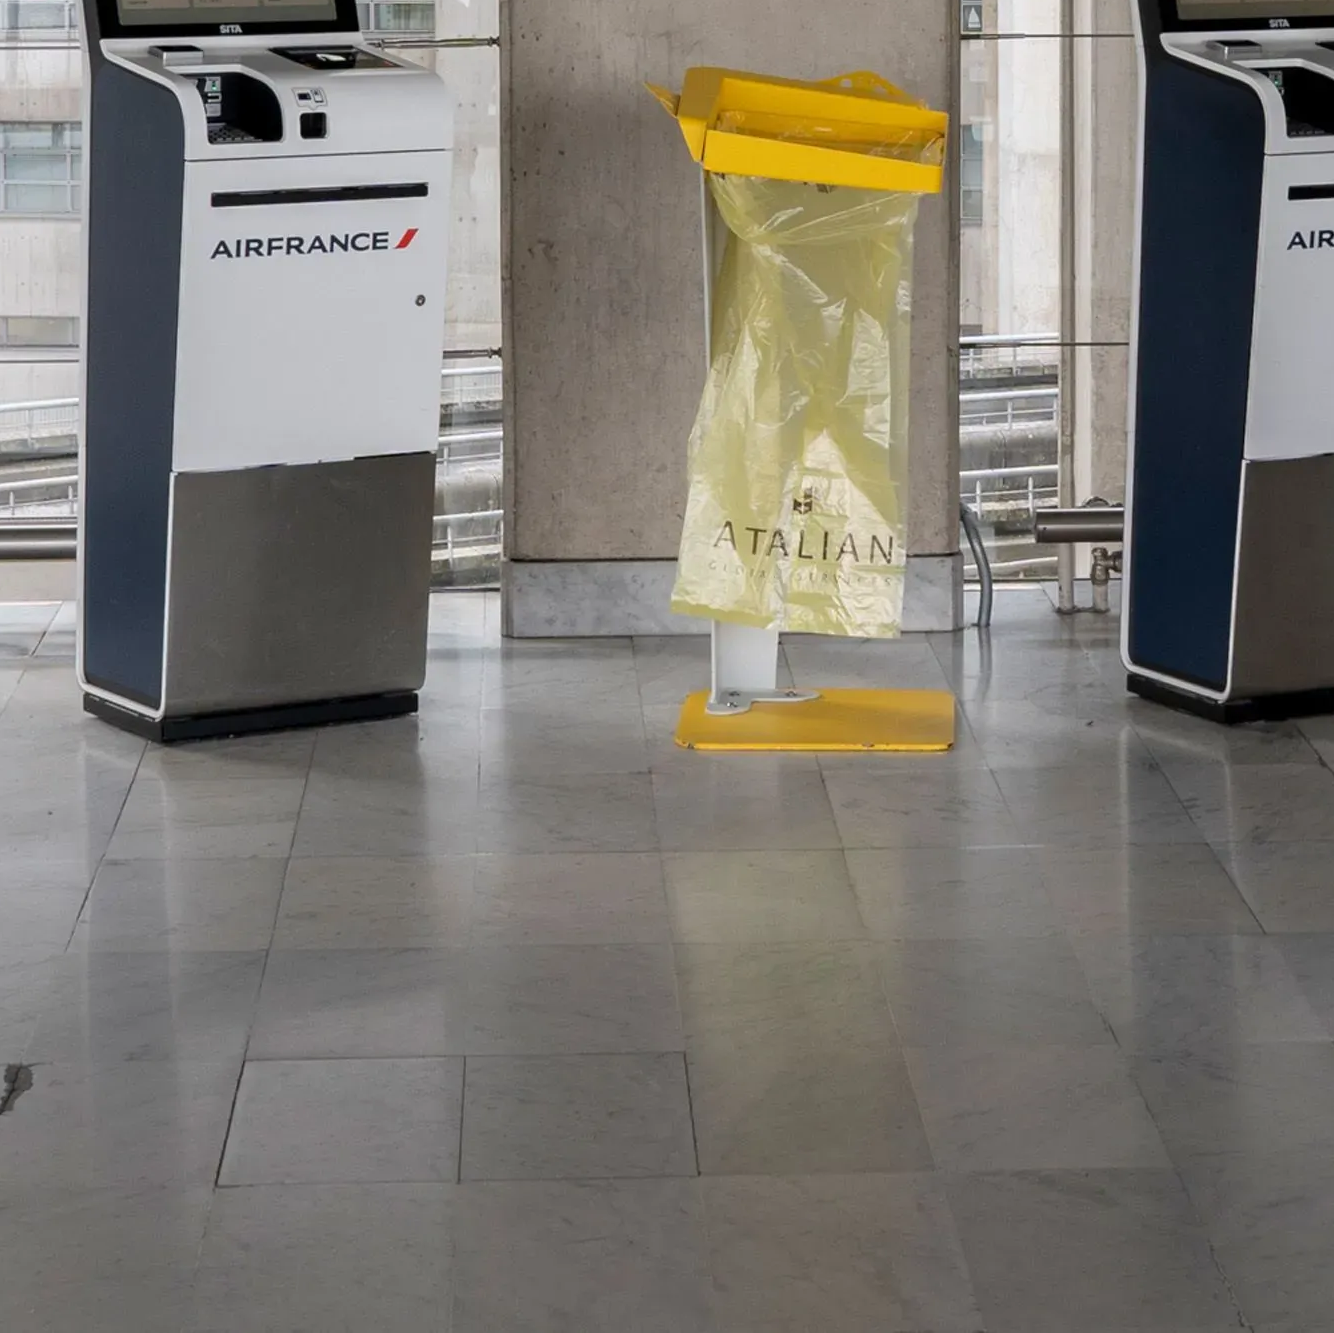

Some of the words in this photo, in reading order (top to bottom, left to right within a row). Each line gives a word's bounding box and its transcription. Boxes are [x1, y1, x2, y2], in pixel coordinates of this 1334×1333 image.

[219, 24, 243, 35] SITA
[1269, 18, 1290, 29] SITA
[210, 231, 390, 260] AIRFRANCE
[713, 520, 894, 565] ATALIAN
